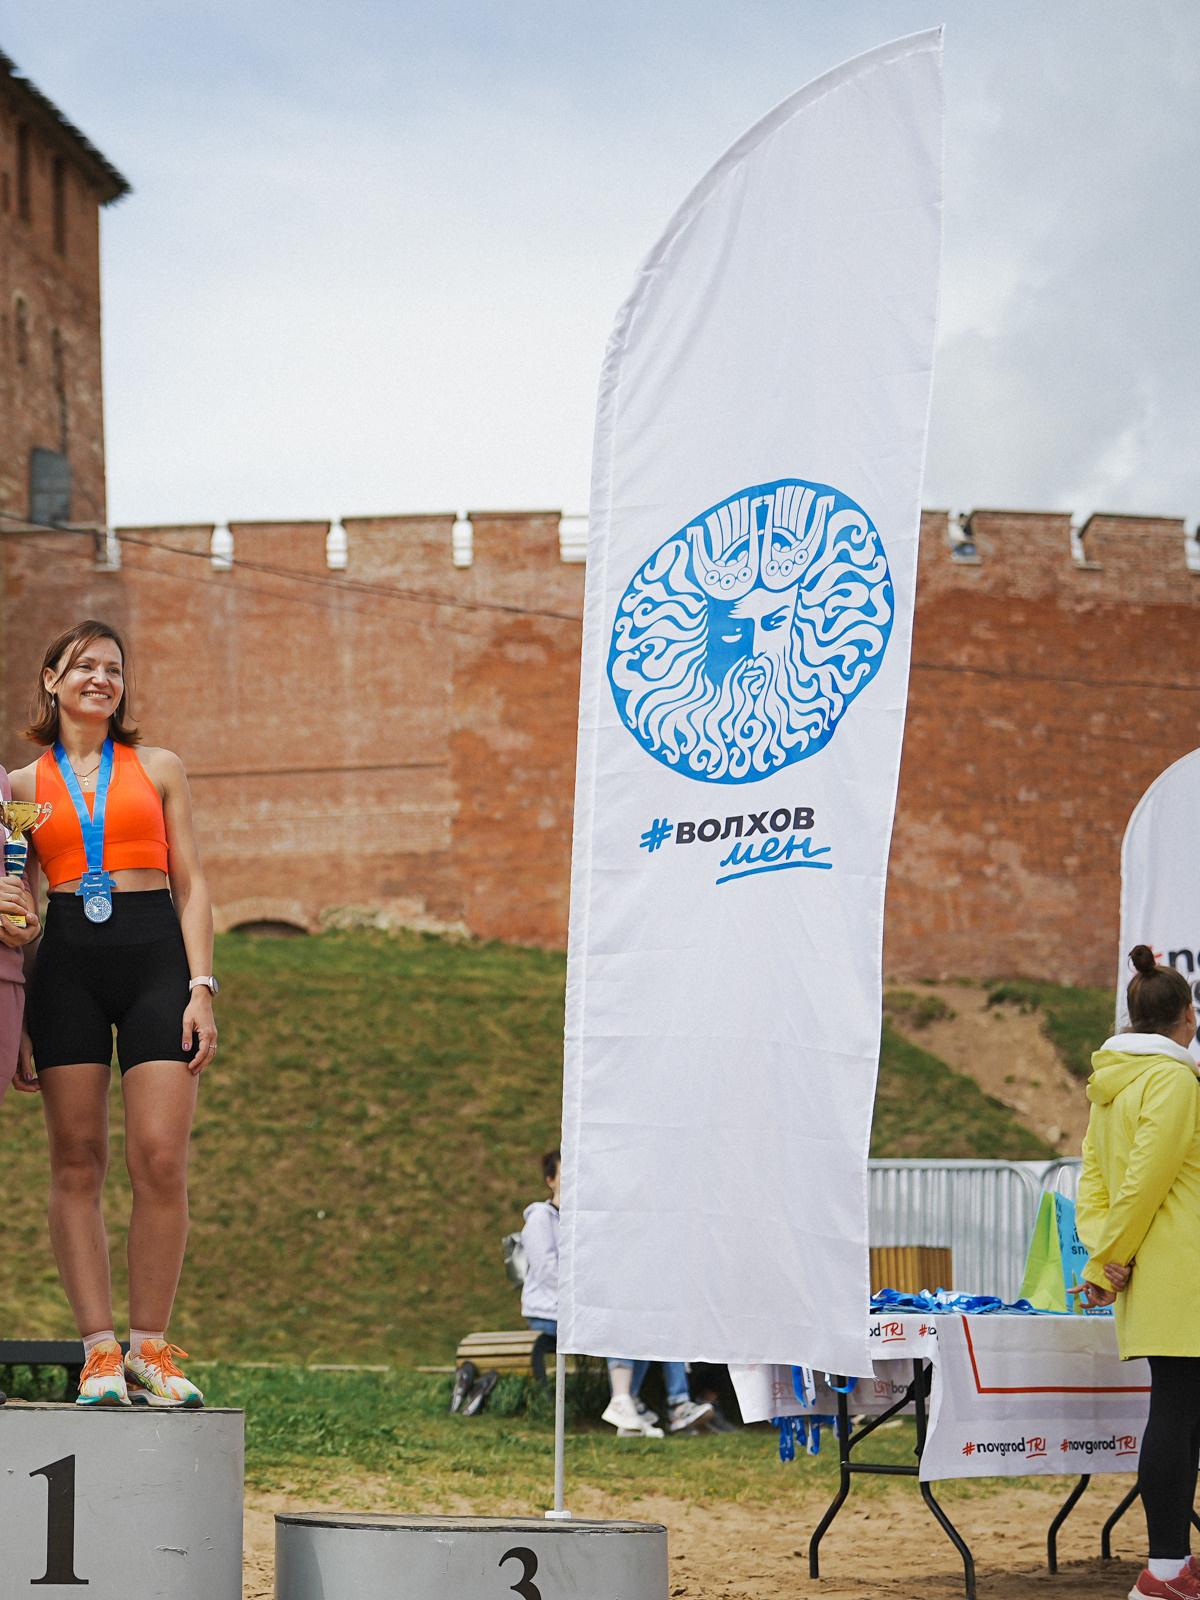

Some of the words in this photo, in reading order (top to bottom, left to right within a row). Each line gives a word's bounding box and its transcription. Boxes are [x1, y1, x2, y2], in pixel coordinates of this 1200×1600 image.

[639, 806, 815, 853] #ВОЛХОВ
[719, 834, 832, 868] мен
[28, 1454, 89, 1585] 1
[498, 1546, 542, 1600] 3
